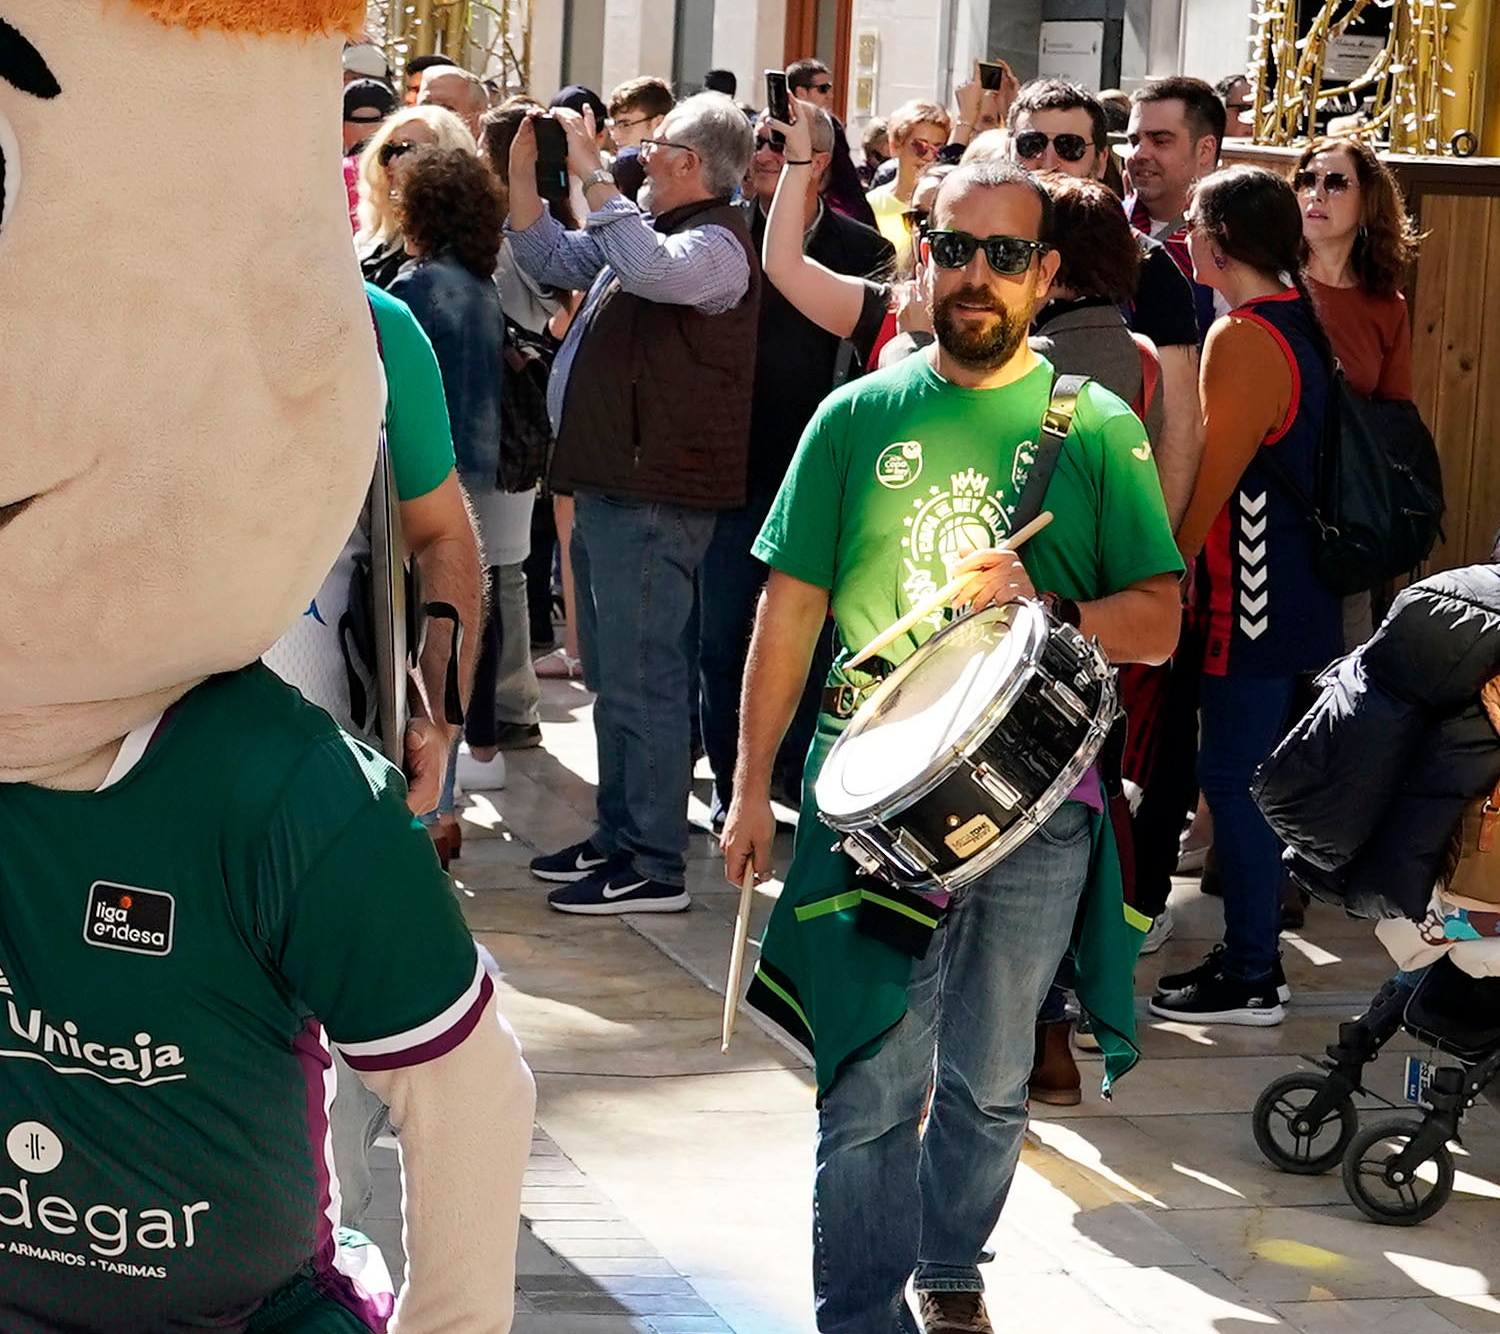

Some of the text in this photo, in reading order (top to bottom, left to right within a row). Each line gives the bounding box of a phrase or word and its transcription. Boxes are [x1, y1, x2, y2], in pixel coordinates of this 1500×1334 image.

[95, 901, 128, 923] liga
[93, 921, 165, 946] endesa
[7, 999, 185, 1079] Unicaja
[7, 1241, 87, 1268] ARMARIOS
[97, 1258, 168, 1279] TARIMAS
